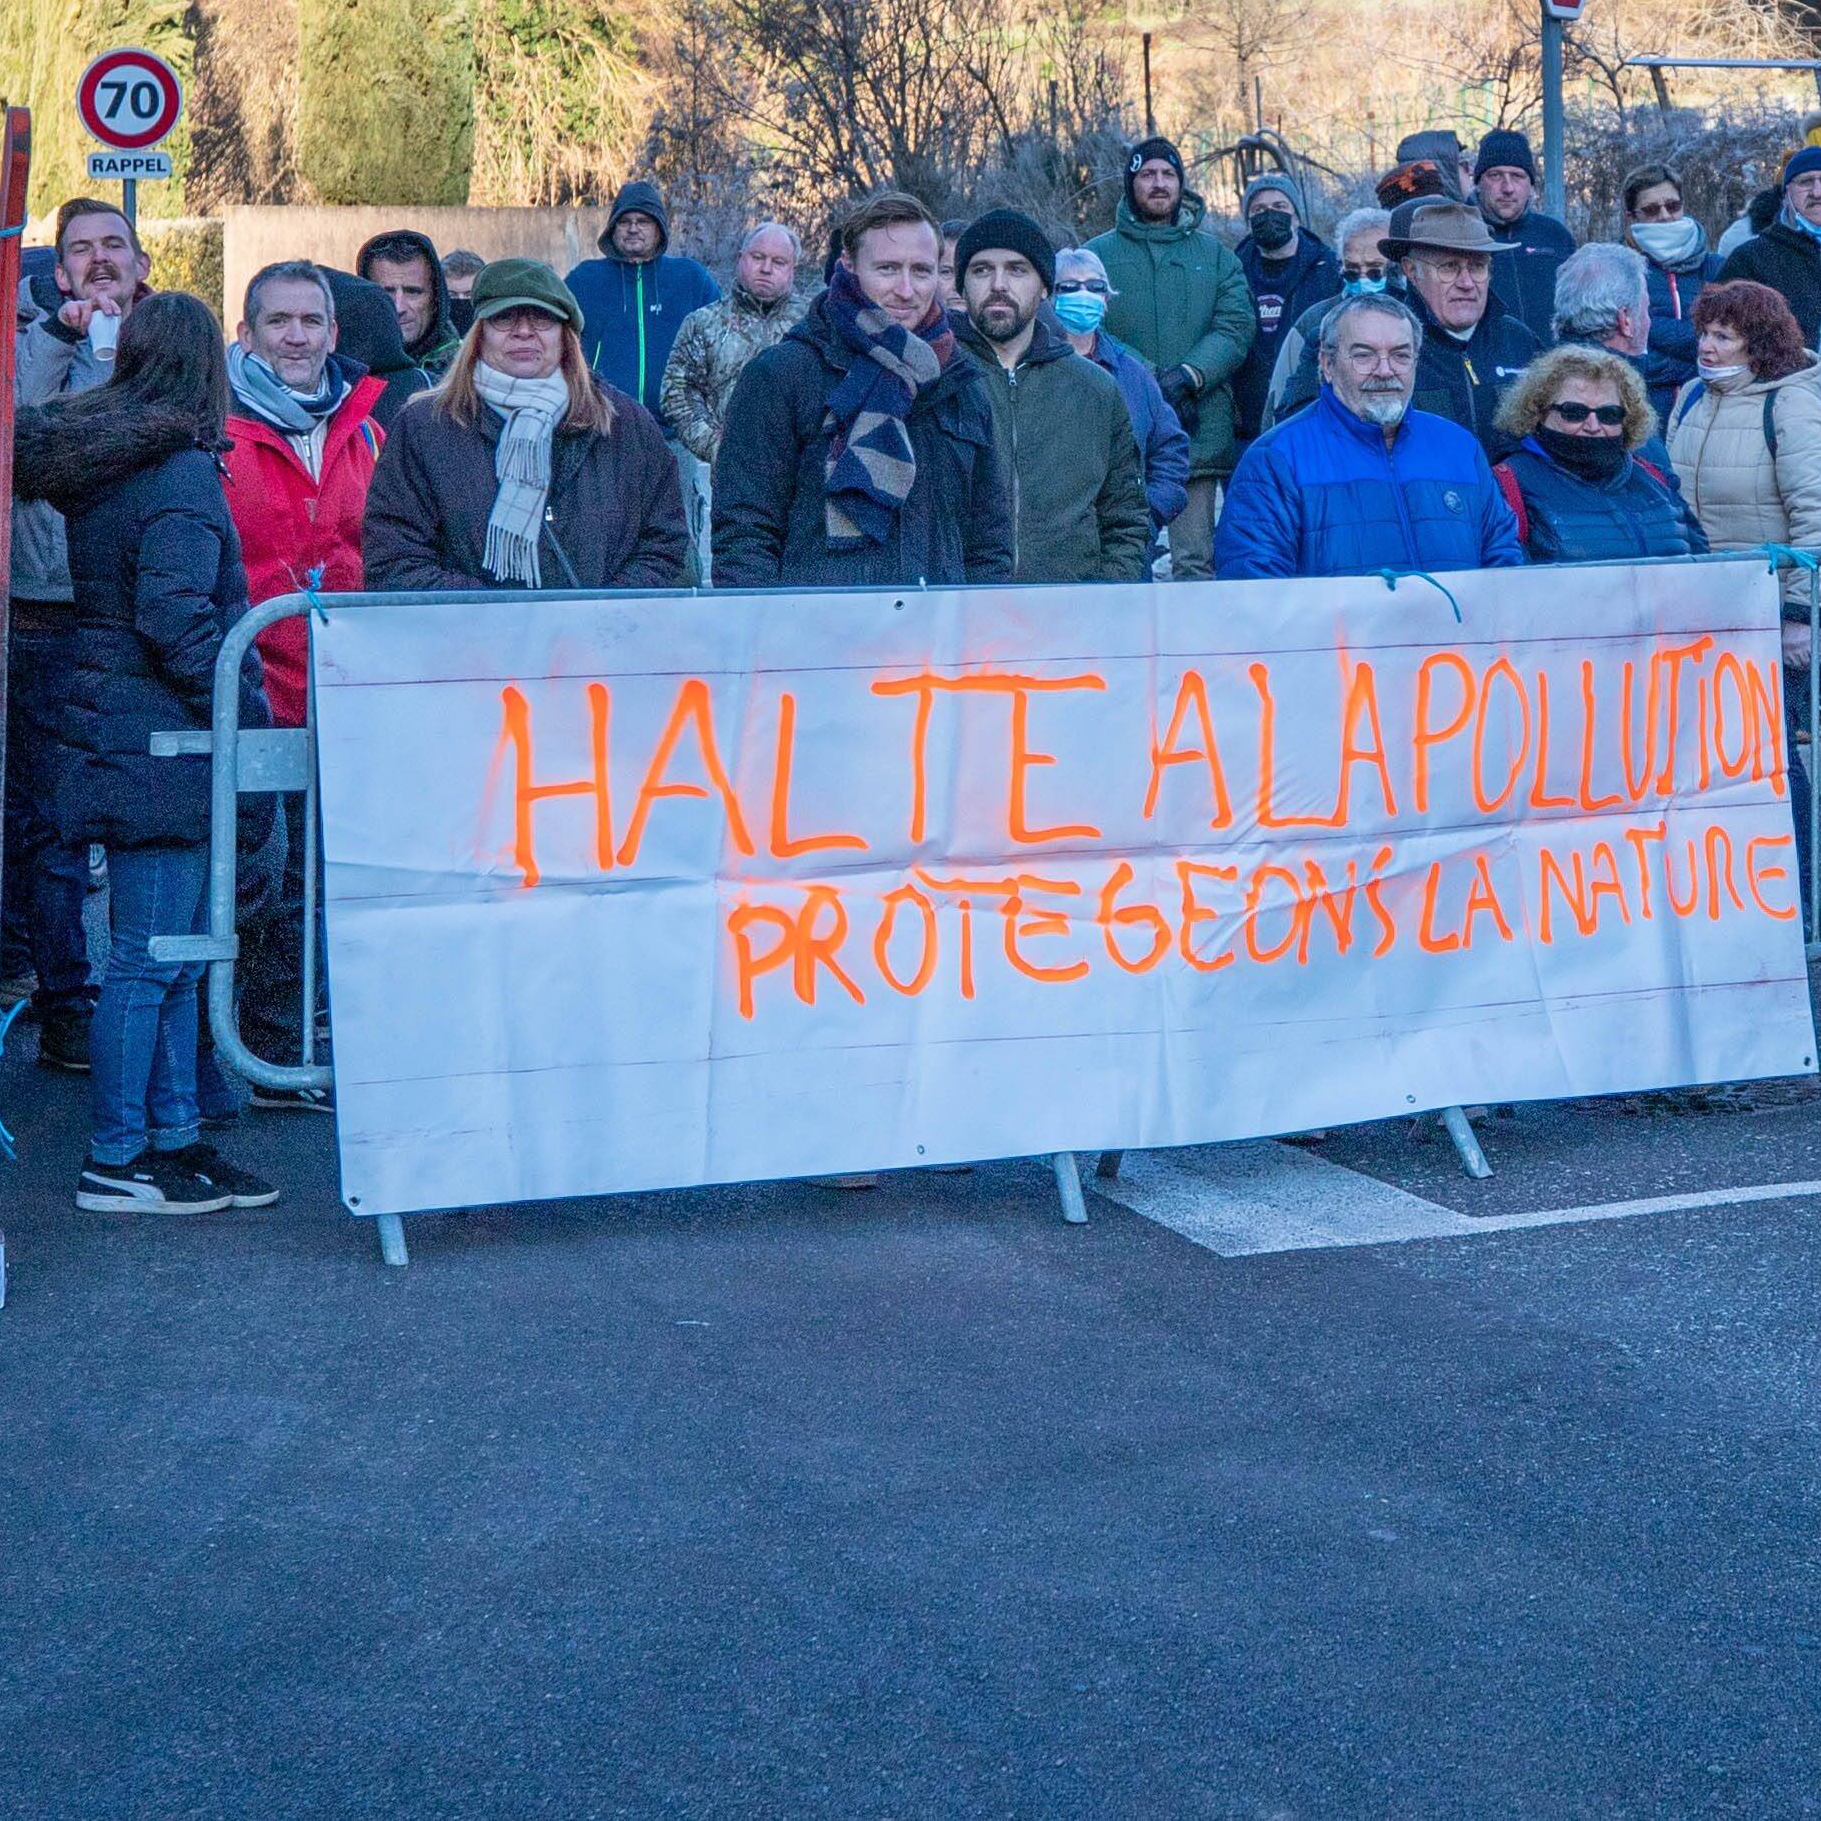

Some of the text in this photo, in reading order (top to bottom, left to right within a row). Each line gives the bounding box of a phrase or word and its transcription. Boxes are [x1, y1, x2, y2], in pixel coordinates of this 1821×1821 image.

[99, 80, 160, 120] 70
[91, 158, 167, 173] RAPPEL
[500, 669, 1108, 888] HALTE
[1539, 821, 1797, 945] NATURE
